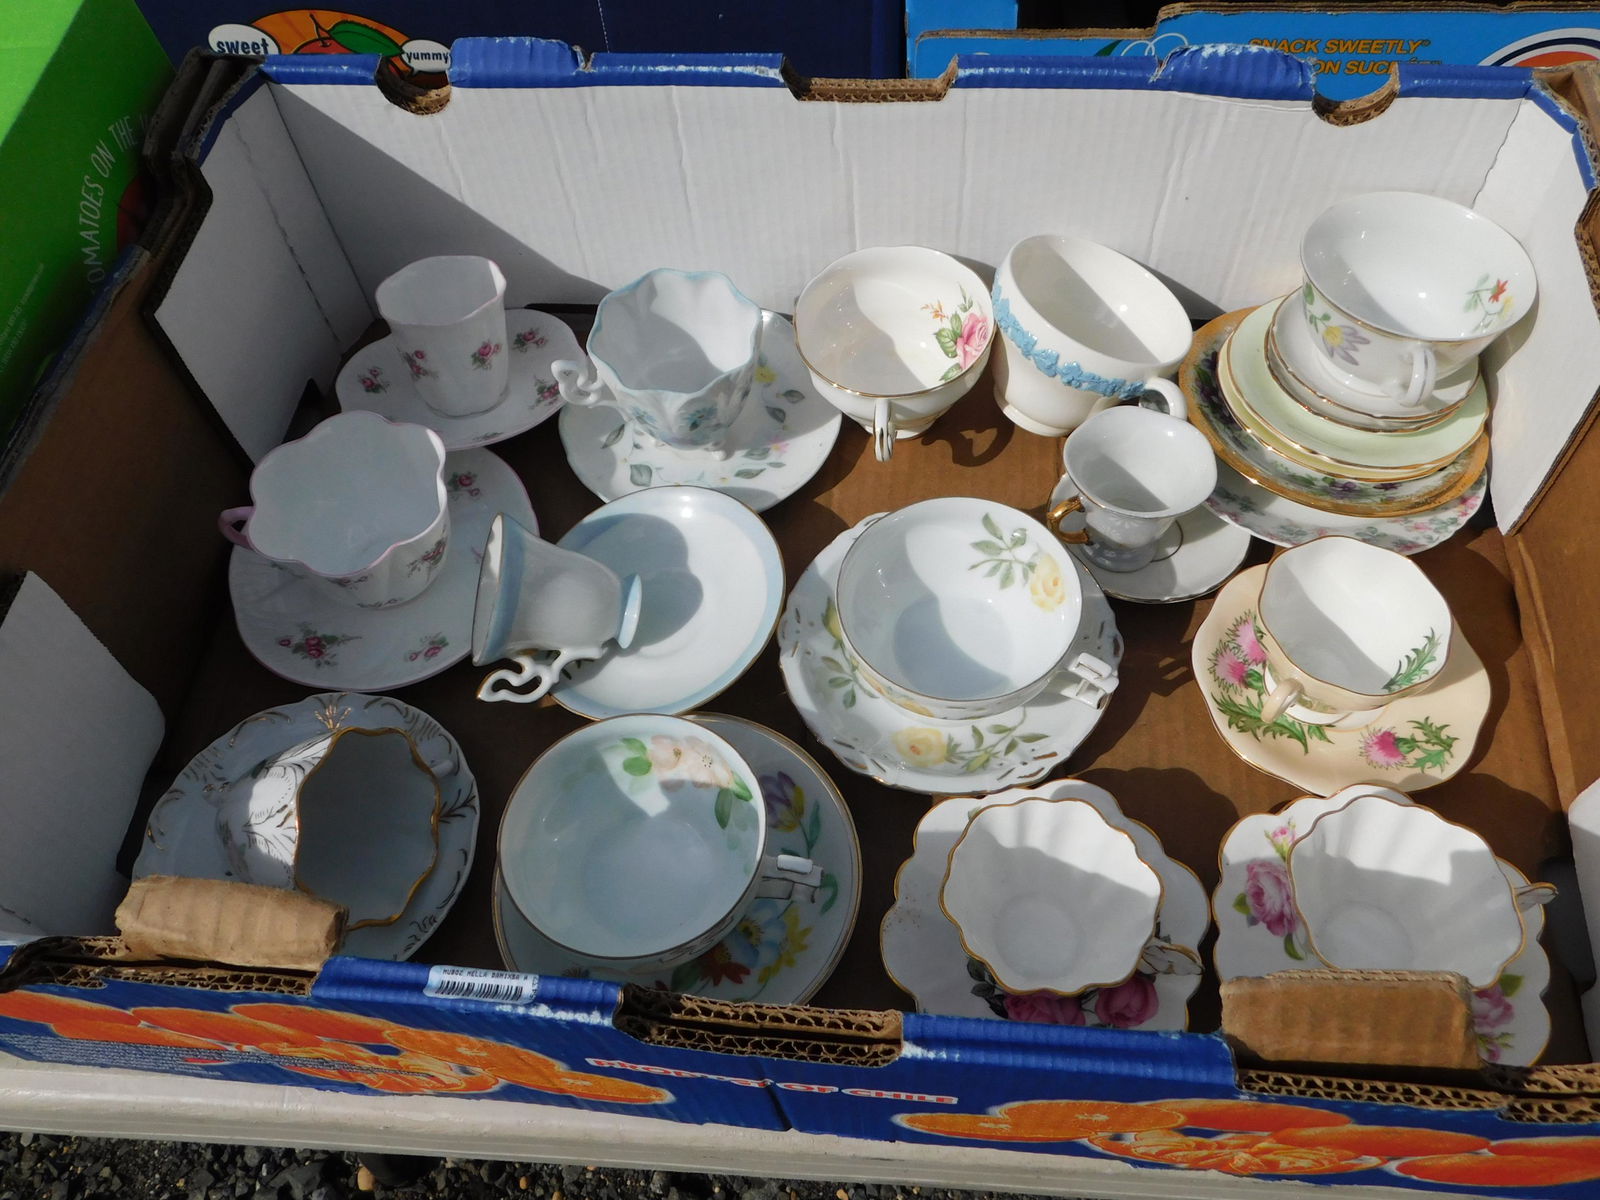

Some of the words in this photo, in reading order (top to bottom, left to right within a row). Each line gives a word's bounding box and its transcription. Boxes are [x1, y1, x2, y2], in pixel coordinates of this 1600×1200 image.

[216, 38, 269, 55] sweet
[405, 52, 450, 64] yummy
[107, 114, 138, 152] THE
[90, 140, 117, 179] ON
[79, 174, 106, 287] OMATOES
